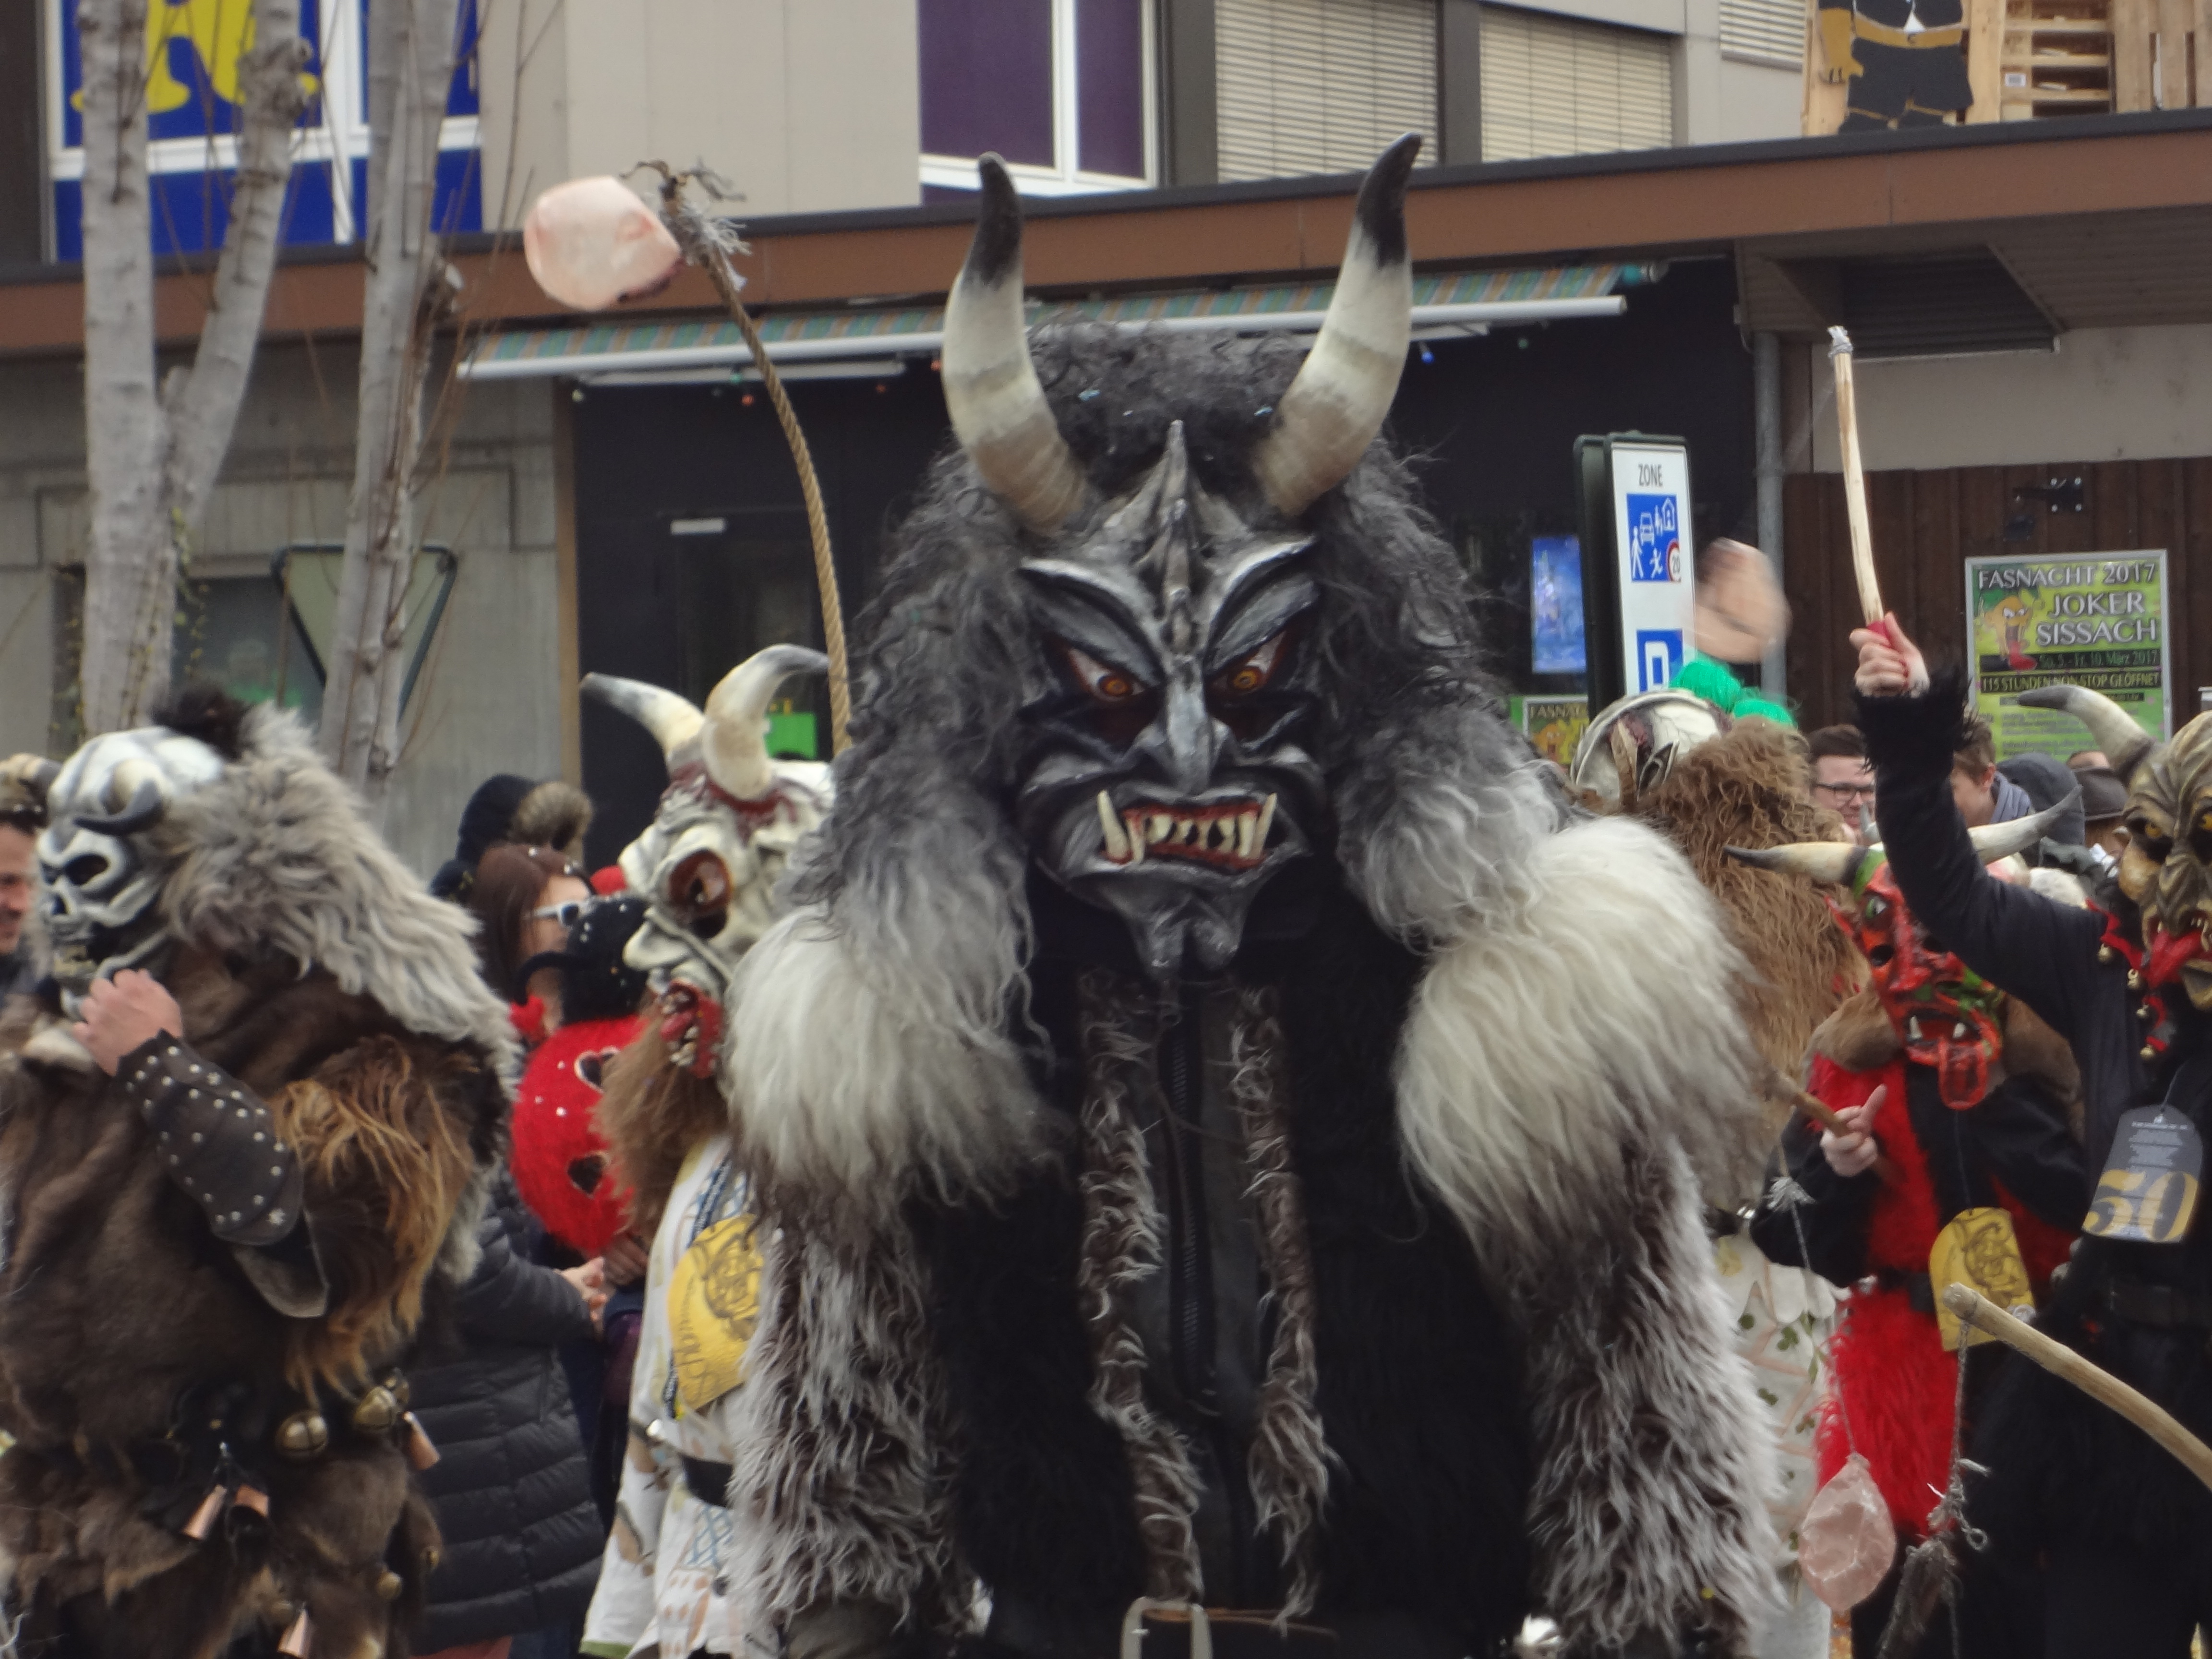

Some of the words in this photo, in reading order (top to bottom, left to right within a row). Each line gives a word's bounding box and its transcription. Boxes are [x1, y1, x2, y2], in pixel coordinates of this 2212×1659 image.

[1638, 464, 1663, 487] ZONE
[1978, 566, 2097, 590] FASNACHT
[2104, 563, 2155, 585] 2017
[2048, 591, 2145, 618] JOKER
[2037, 619, 2157, 647] SISSACH
[1984, 677, 1999, 692] 115
[2083, 1169, 2199, 1242] 50
